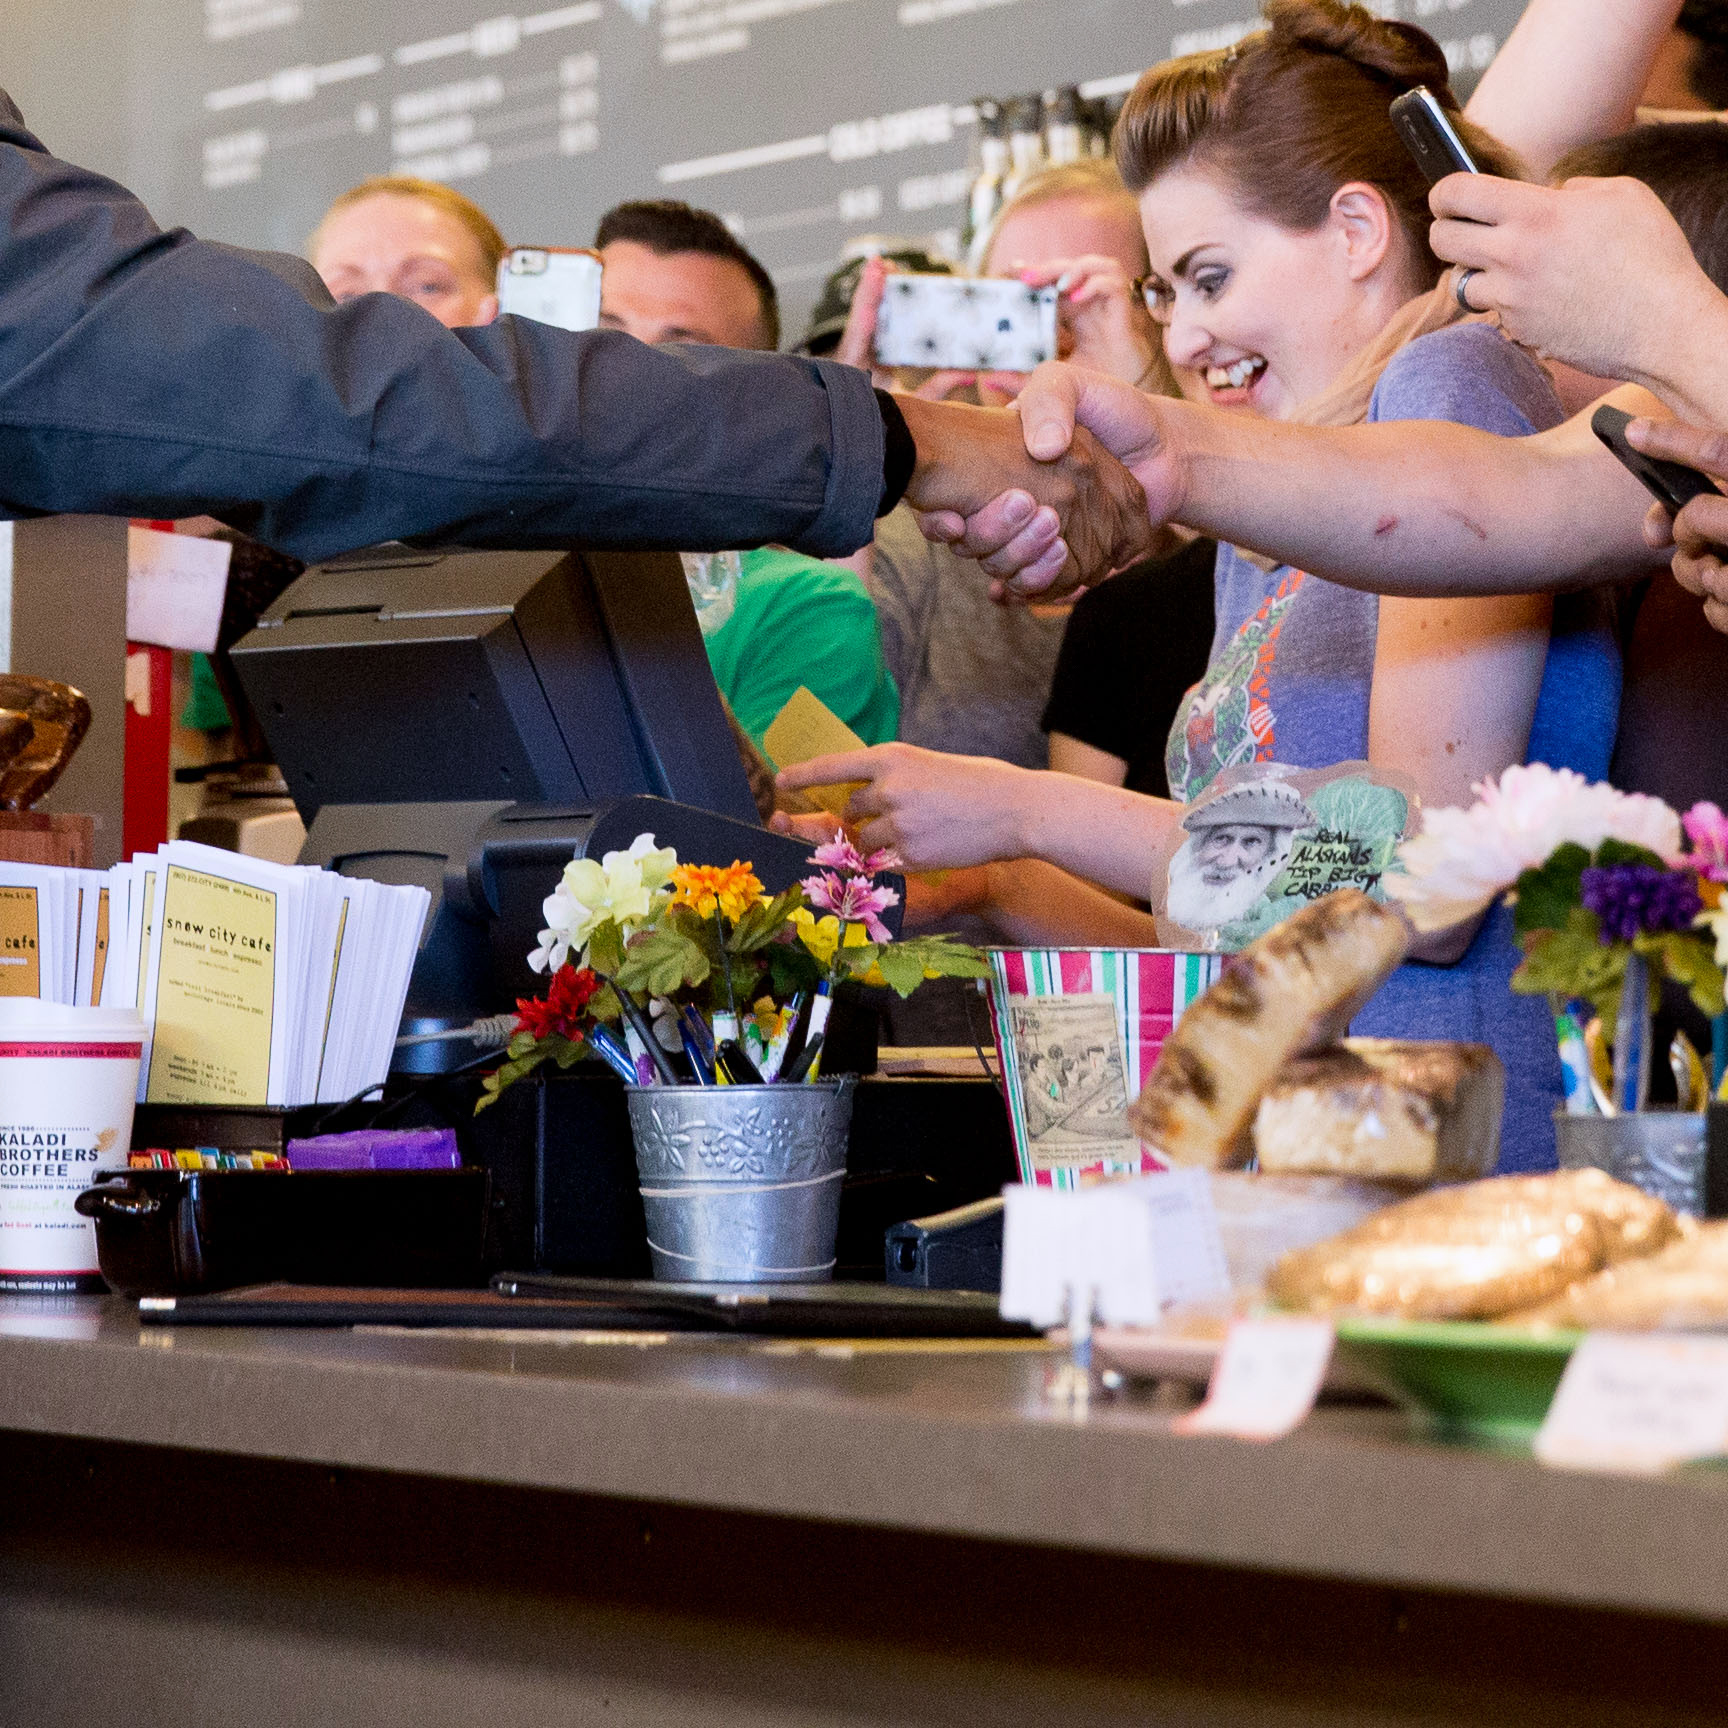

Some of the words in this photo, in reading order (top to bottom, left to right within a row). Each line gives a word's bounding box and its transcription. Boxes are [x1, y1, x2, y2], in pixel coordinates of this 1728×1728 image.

[1292, 844, 1373, 865] ALASKANS
[1286, 865, 1322, 881] TIP
[5, 934, 37, 950] cafe
[167, 917, 204, 936] snow
[209, 925, 237, 947] city
[241, 934, 272, 953] cafe
[173, 937, 206, 953] breakfast
[210, 945, 230, 957] lunch
[233, 952, 264, 967] espresso
[0, 1148, 99, 1162] BROTHERS
[0, 1163, 68, 1177] COFFEE
